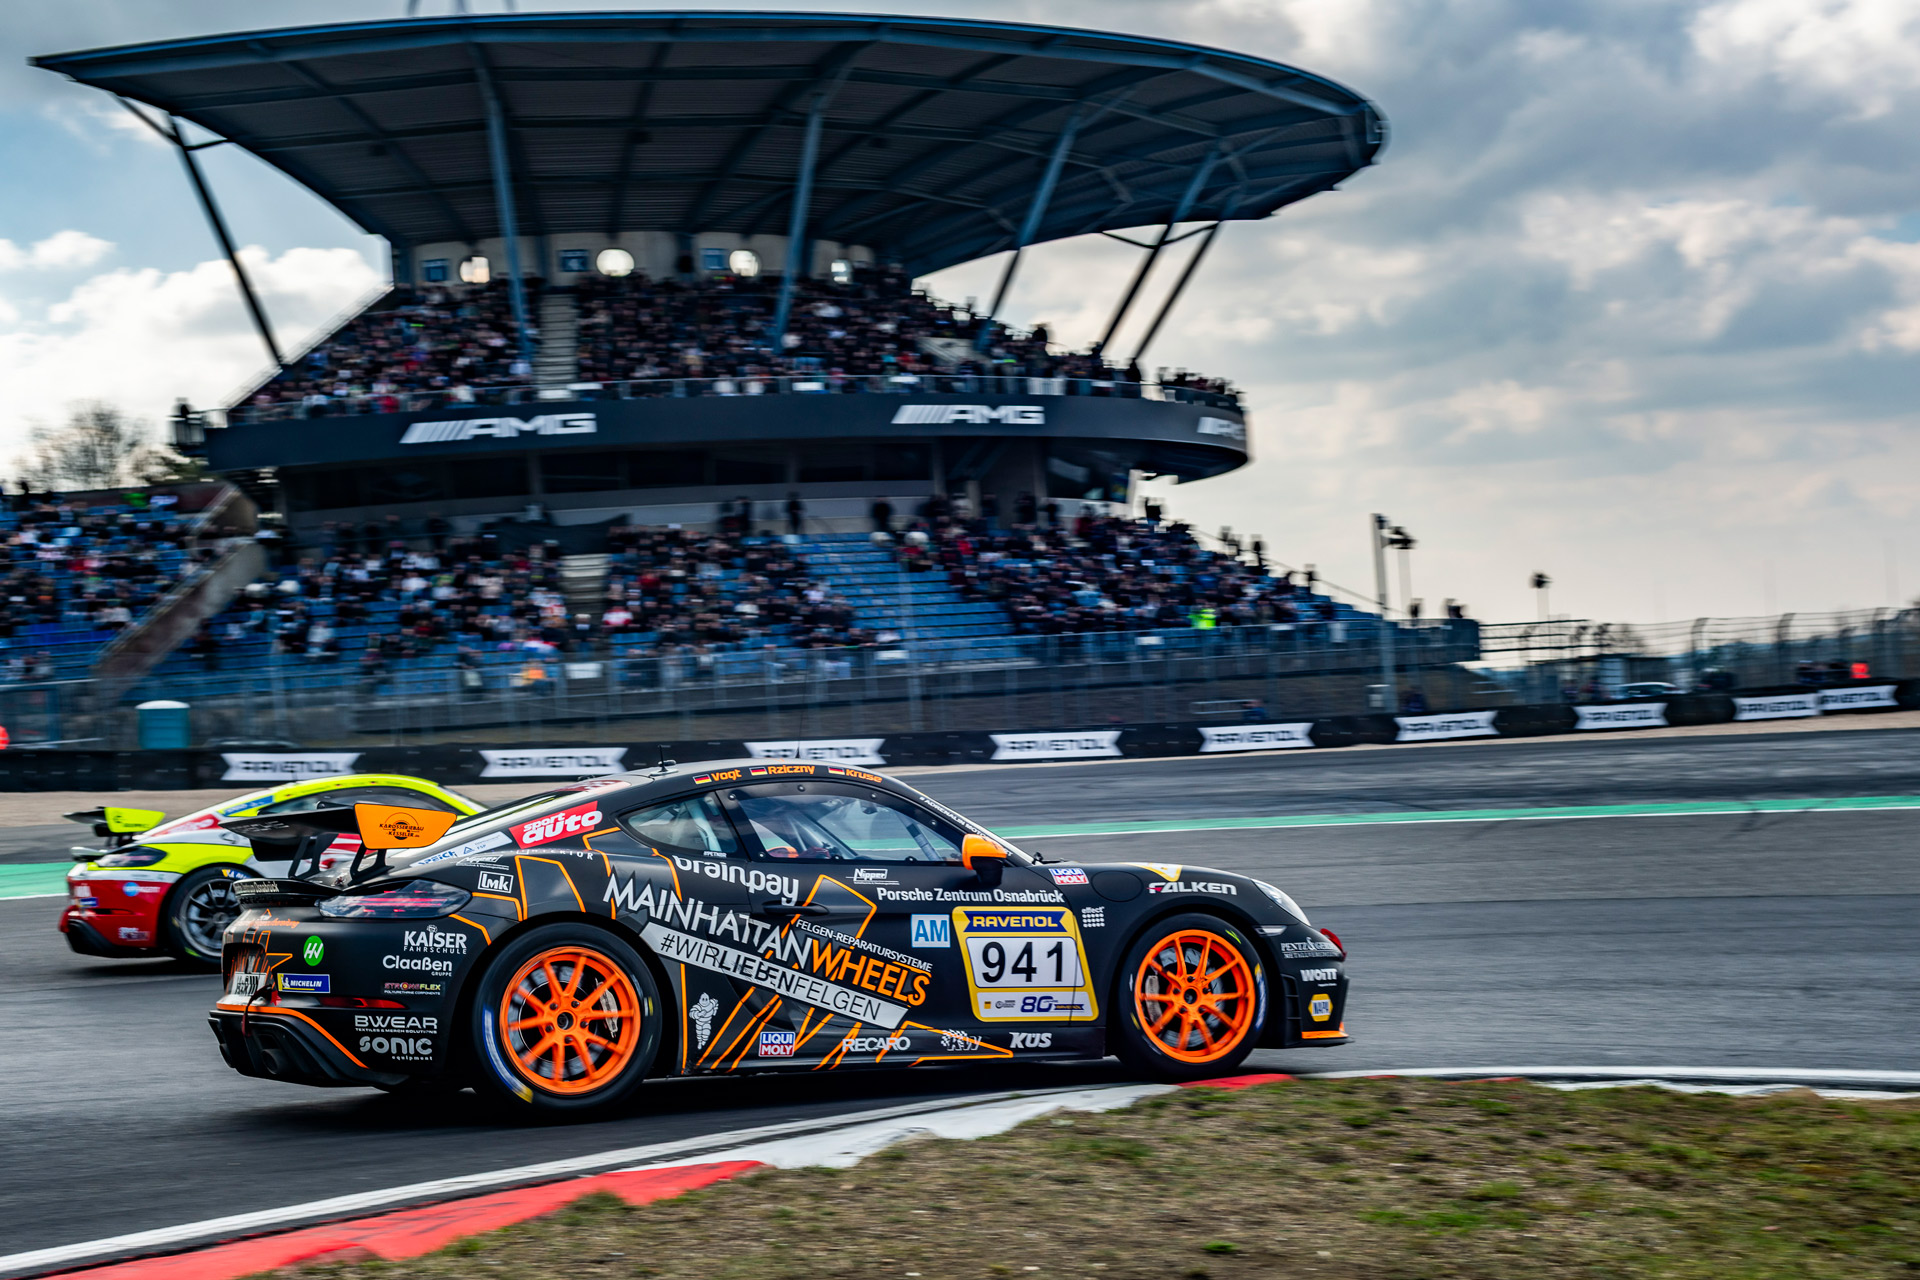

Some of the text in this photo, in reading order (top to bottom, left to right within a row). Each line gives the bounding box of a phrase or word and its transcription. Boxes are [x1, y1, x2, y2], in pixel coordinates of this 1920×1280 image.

[940, 405, 1044, 424] AMG
[468, 413, 597, 438] AMG
[711, 768, 742, 782] Vogt
[768, 764, 816, 776] Rziczny
[846, 769, 883, 783] Kruse
[522, 811, 603, 844] auto
[523, 812, 566, 832] sport
[854, 868, 887, 881] Nipper
[1050, 868, 1084, 878] LIQUI
[1055, 875, 1087, 885] MOLY
[877, 887, 1065, 903] Porsche Zentrum Osnabrück
[1148, 882, 1238, 896] FALKEN
[973, 916, 1058, 928] RAVENOL
[915, 919, 948, 943] AM
[404, 931, 467, 949] KAISER
[796, 919, 933, 973] FELGEN-REPARATURSYSTEME
[404, 946, 467, 954] FAHRSCHULE
[383, 955, 453, 971] Claaßen
[982, 941, 1063, 983] 941
[660, 934, 881, 1020] #WIRLIEBENFELGEN
[355, 1015, 438, 1029] BWEAR
[761, 1033, 794, 1044] LIQUI
[842, 1035, 911, 1051] RECARO
[1009, 1031, 1052, 1049] KÜS
[761, 1045, 794, 1056] MOLY
